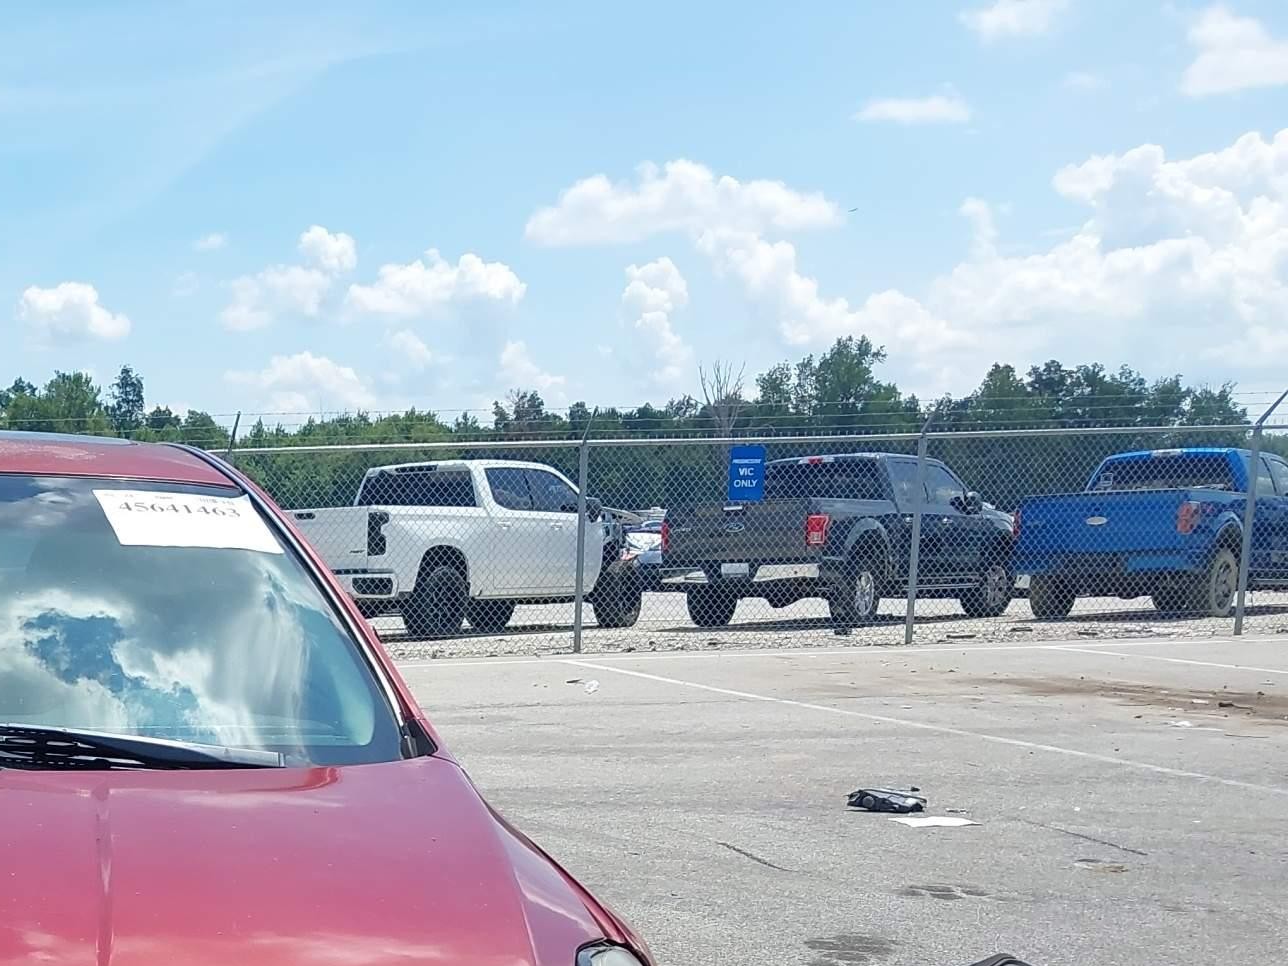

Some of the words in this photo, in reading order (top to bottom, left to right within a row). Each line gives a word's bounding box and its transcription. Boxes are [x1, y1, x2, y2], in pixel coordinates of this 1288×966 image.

[739, 467, 754, 476] VIC
[733, 479, 758, 488] ONLY
[119, 502, 241, 517] 45641463
